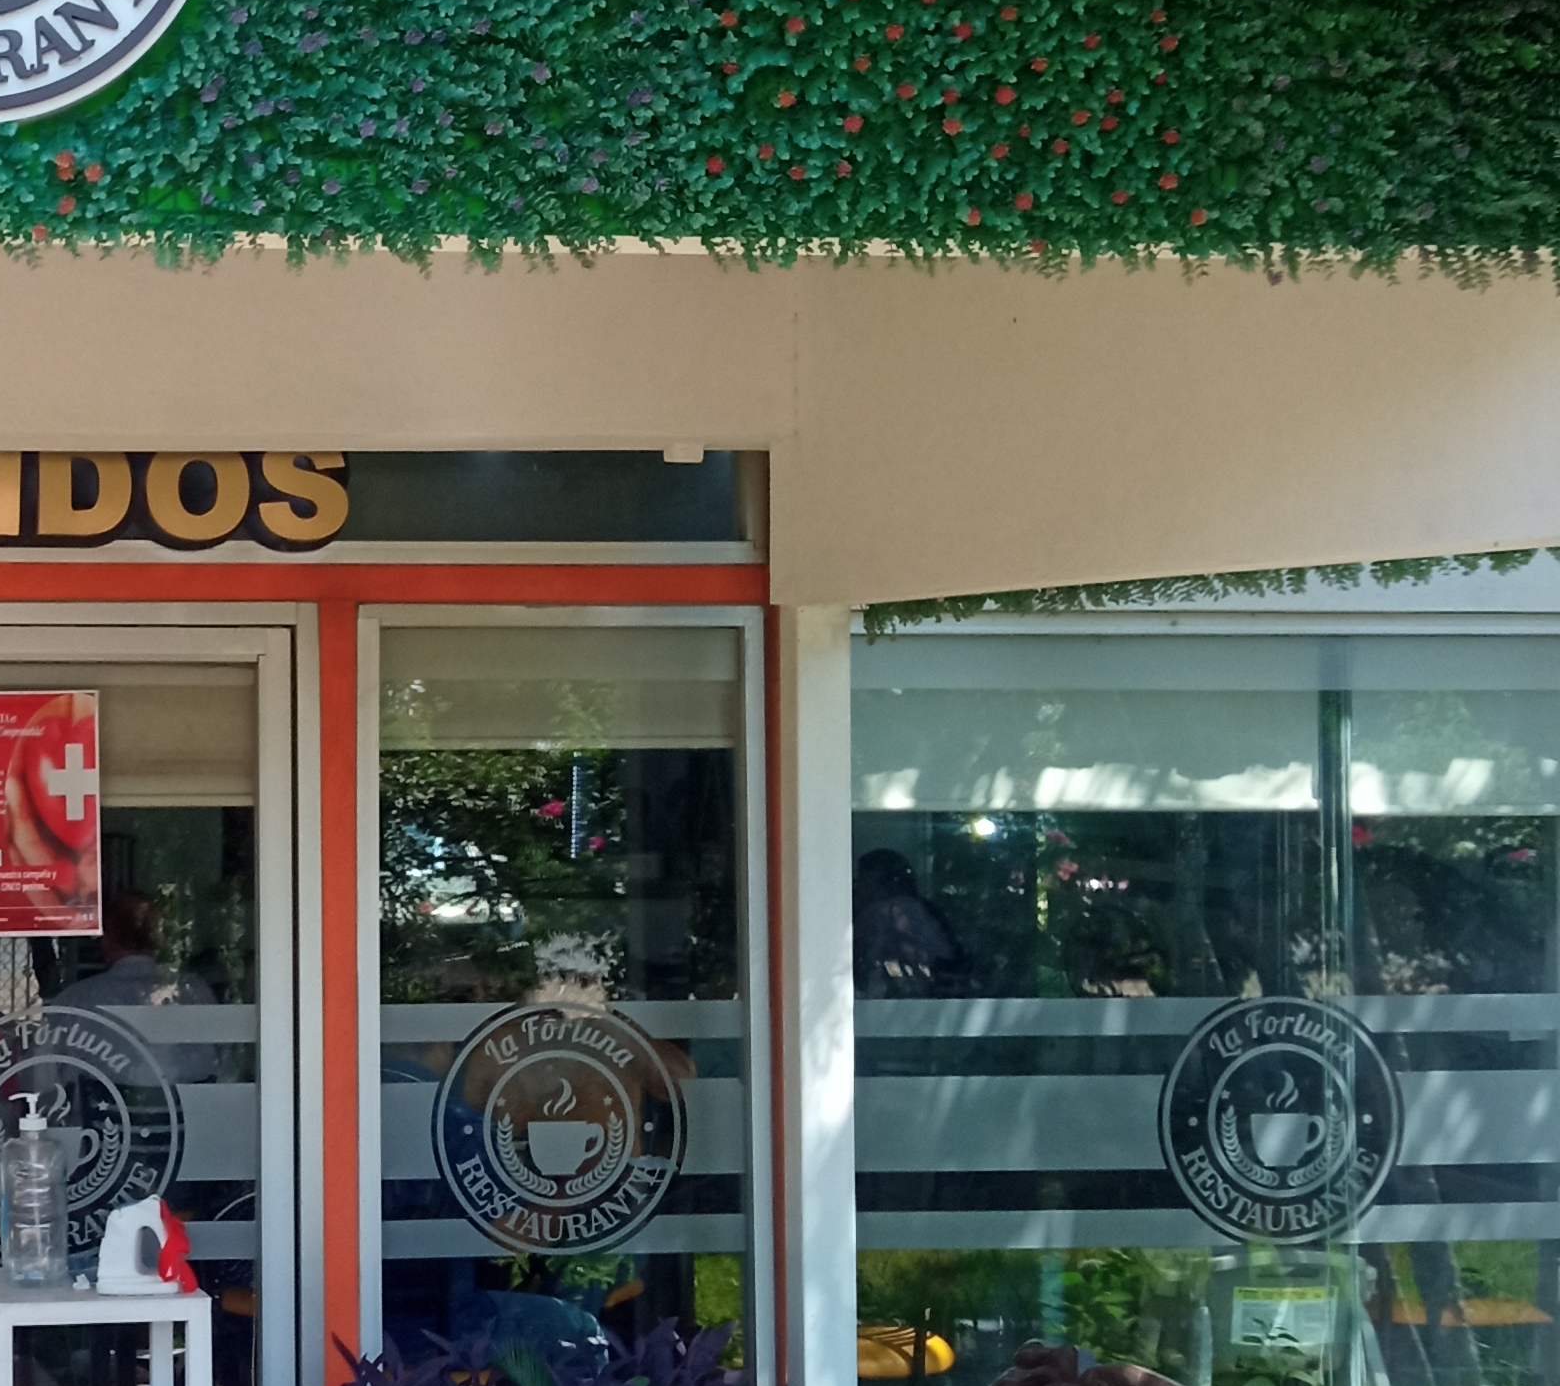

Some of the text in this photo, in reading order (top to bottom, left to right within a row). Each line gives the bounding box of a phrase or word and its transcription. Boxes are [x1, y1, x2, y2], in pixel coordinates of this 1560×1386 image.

[15, 1020, 131, 1074] Fortuna
[483, 1014, 635, 1069] La Fortuna
[1208, 1009, 1354, 1062] La Fortuna
[455, 1153, 665, 1243] RESTAURANTE
[1180, 1144, 1381, 1232] RESTAURANTE
